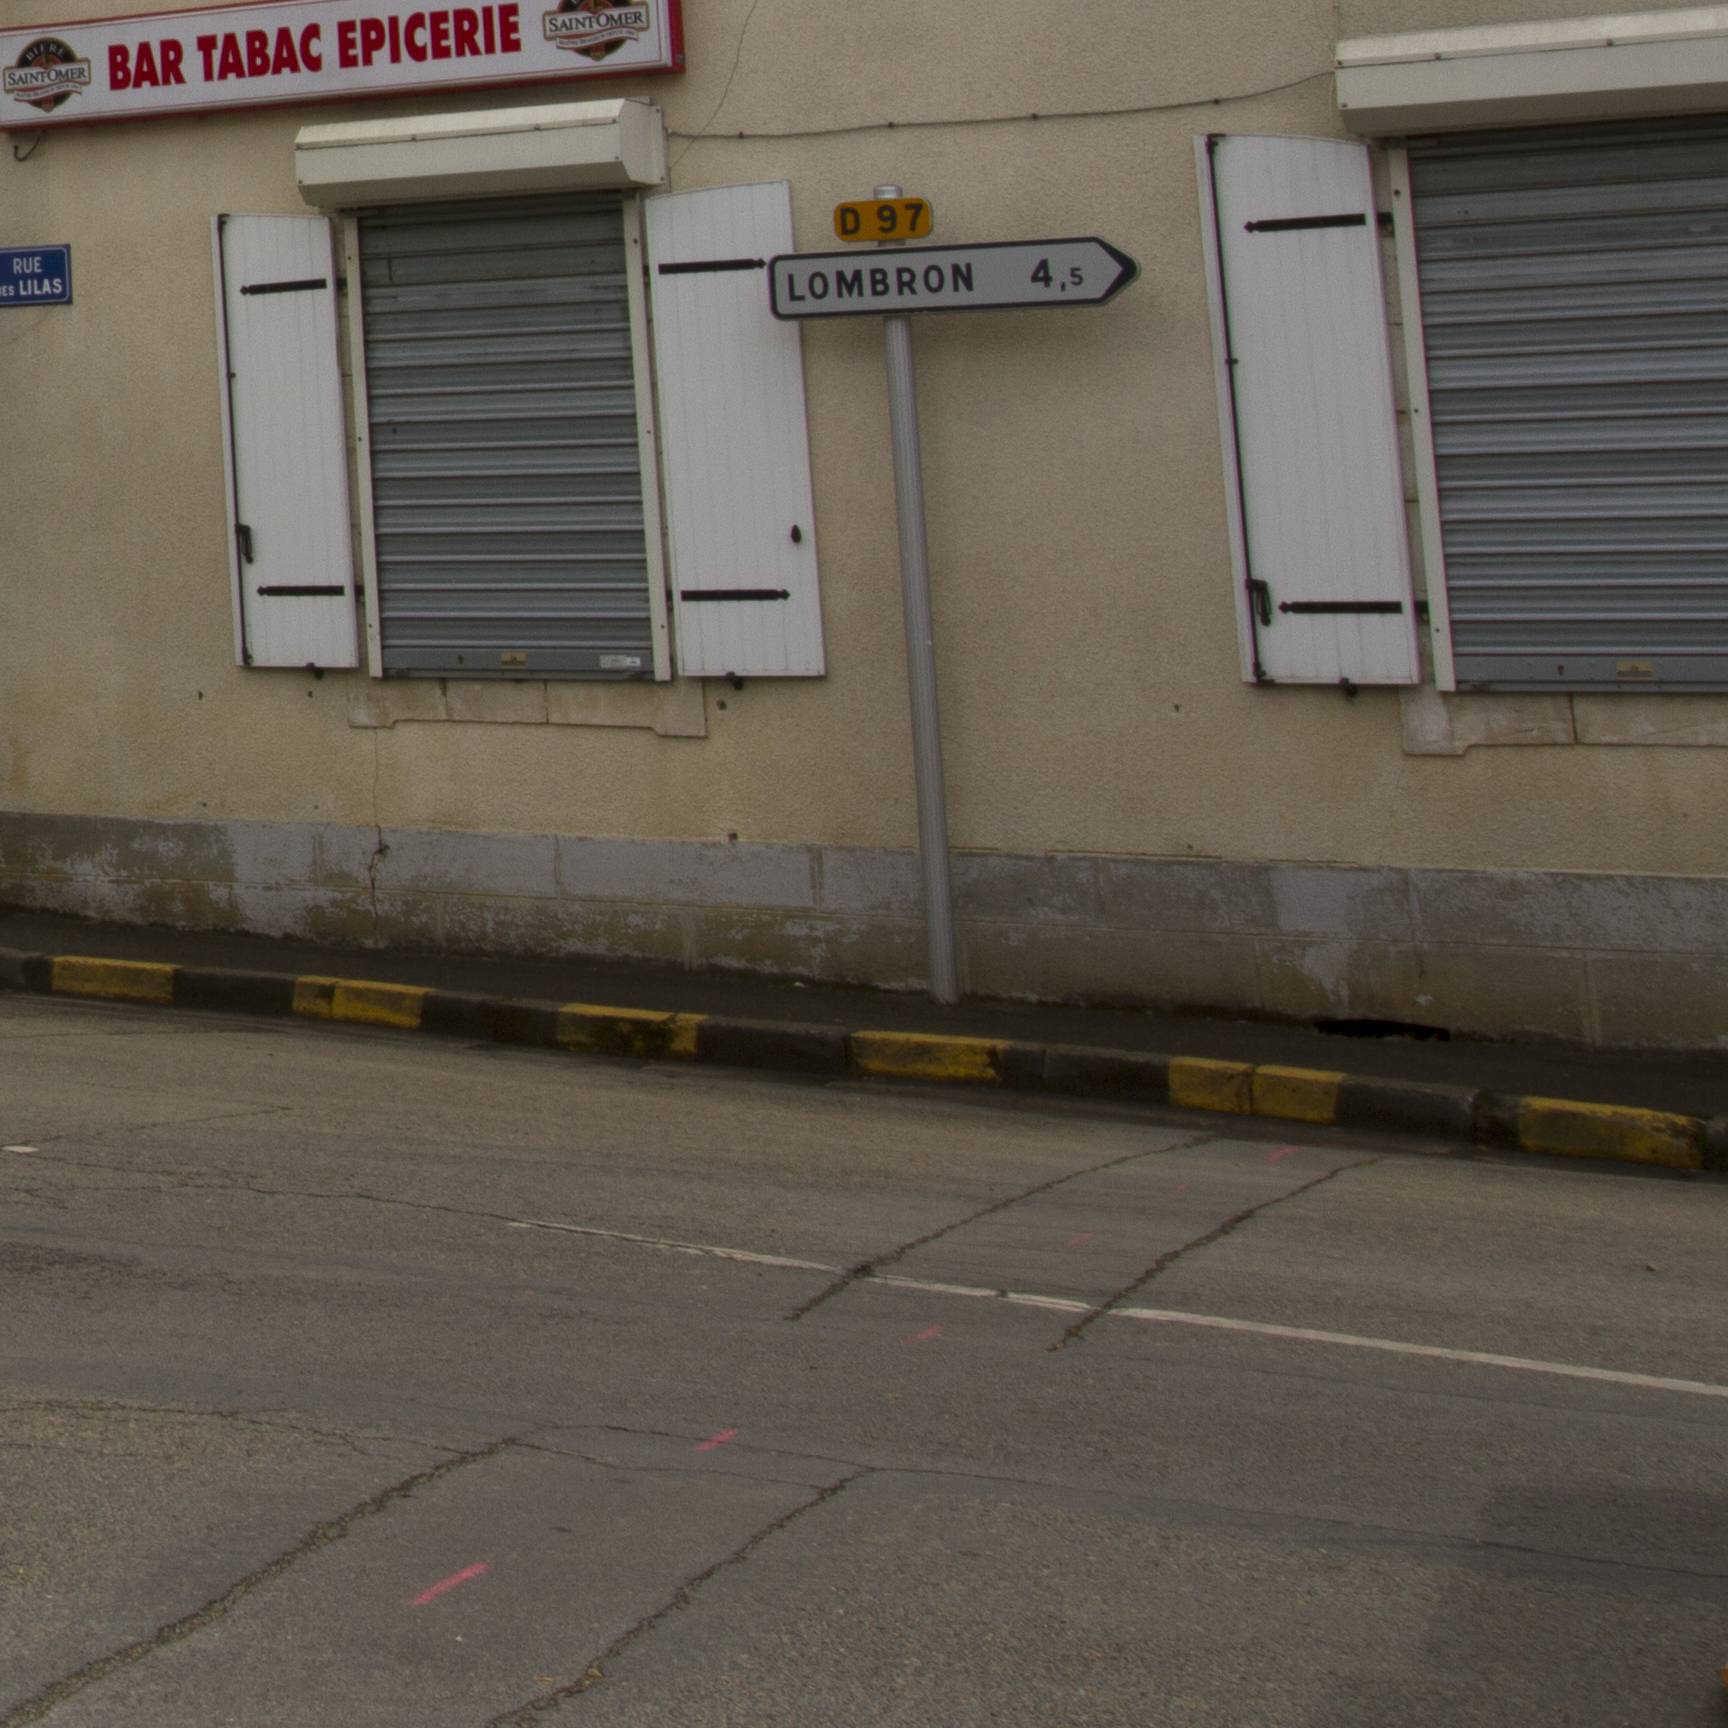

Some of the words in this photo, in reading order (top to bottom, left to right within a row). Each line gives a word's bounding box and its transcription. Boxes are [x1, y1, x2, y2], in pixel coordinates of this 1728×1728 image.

[108, 38, 187, 91] BAR
[196, 23, 323, 82] TABAC
[337, 3, 522, 69] EPICERIE
[840, 207, 861, 236] D
[876, 203, 924, 233] 97
[13, 257, 42, 274] RUE
[788, 263, 974, 302] LOMBRON
[1030, 258, 1084, 292] 4,5
[19, 278, 62, 295] LILAS
